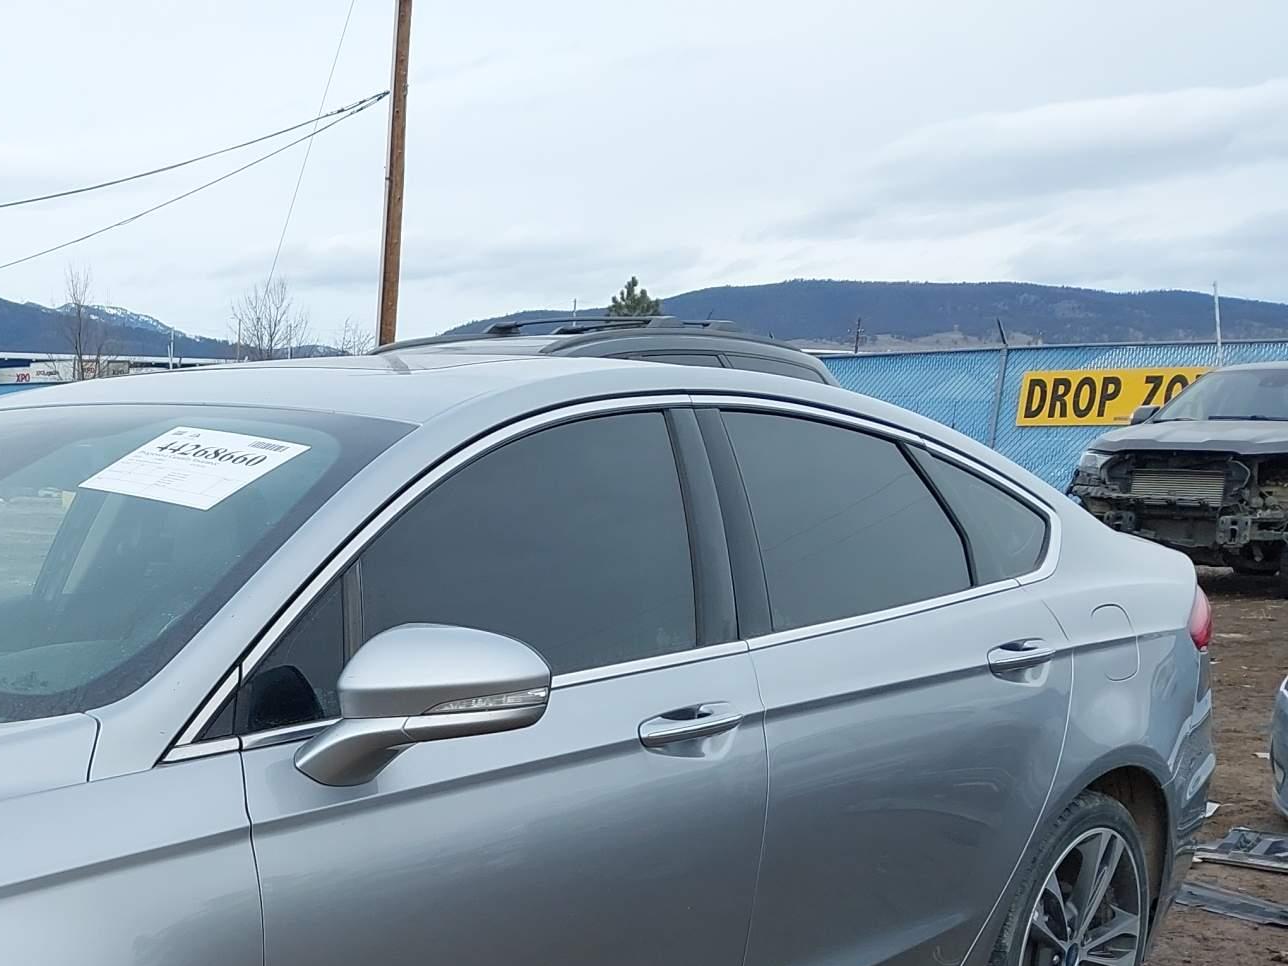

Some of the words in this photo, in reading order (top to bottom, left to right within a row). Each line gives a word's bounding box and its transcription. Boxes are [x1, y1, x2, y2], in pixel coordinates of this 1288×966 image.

[15, 373, 31, 383] XPO
[1023, 376, 1122, 418] DROP
[1141, 374, 1203, 407] ZO
[157, 441, 268, 467] 44268660
